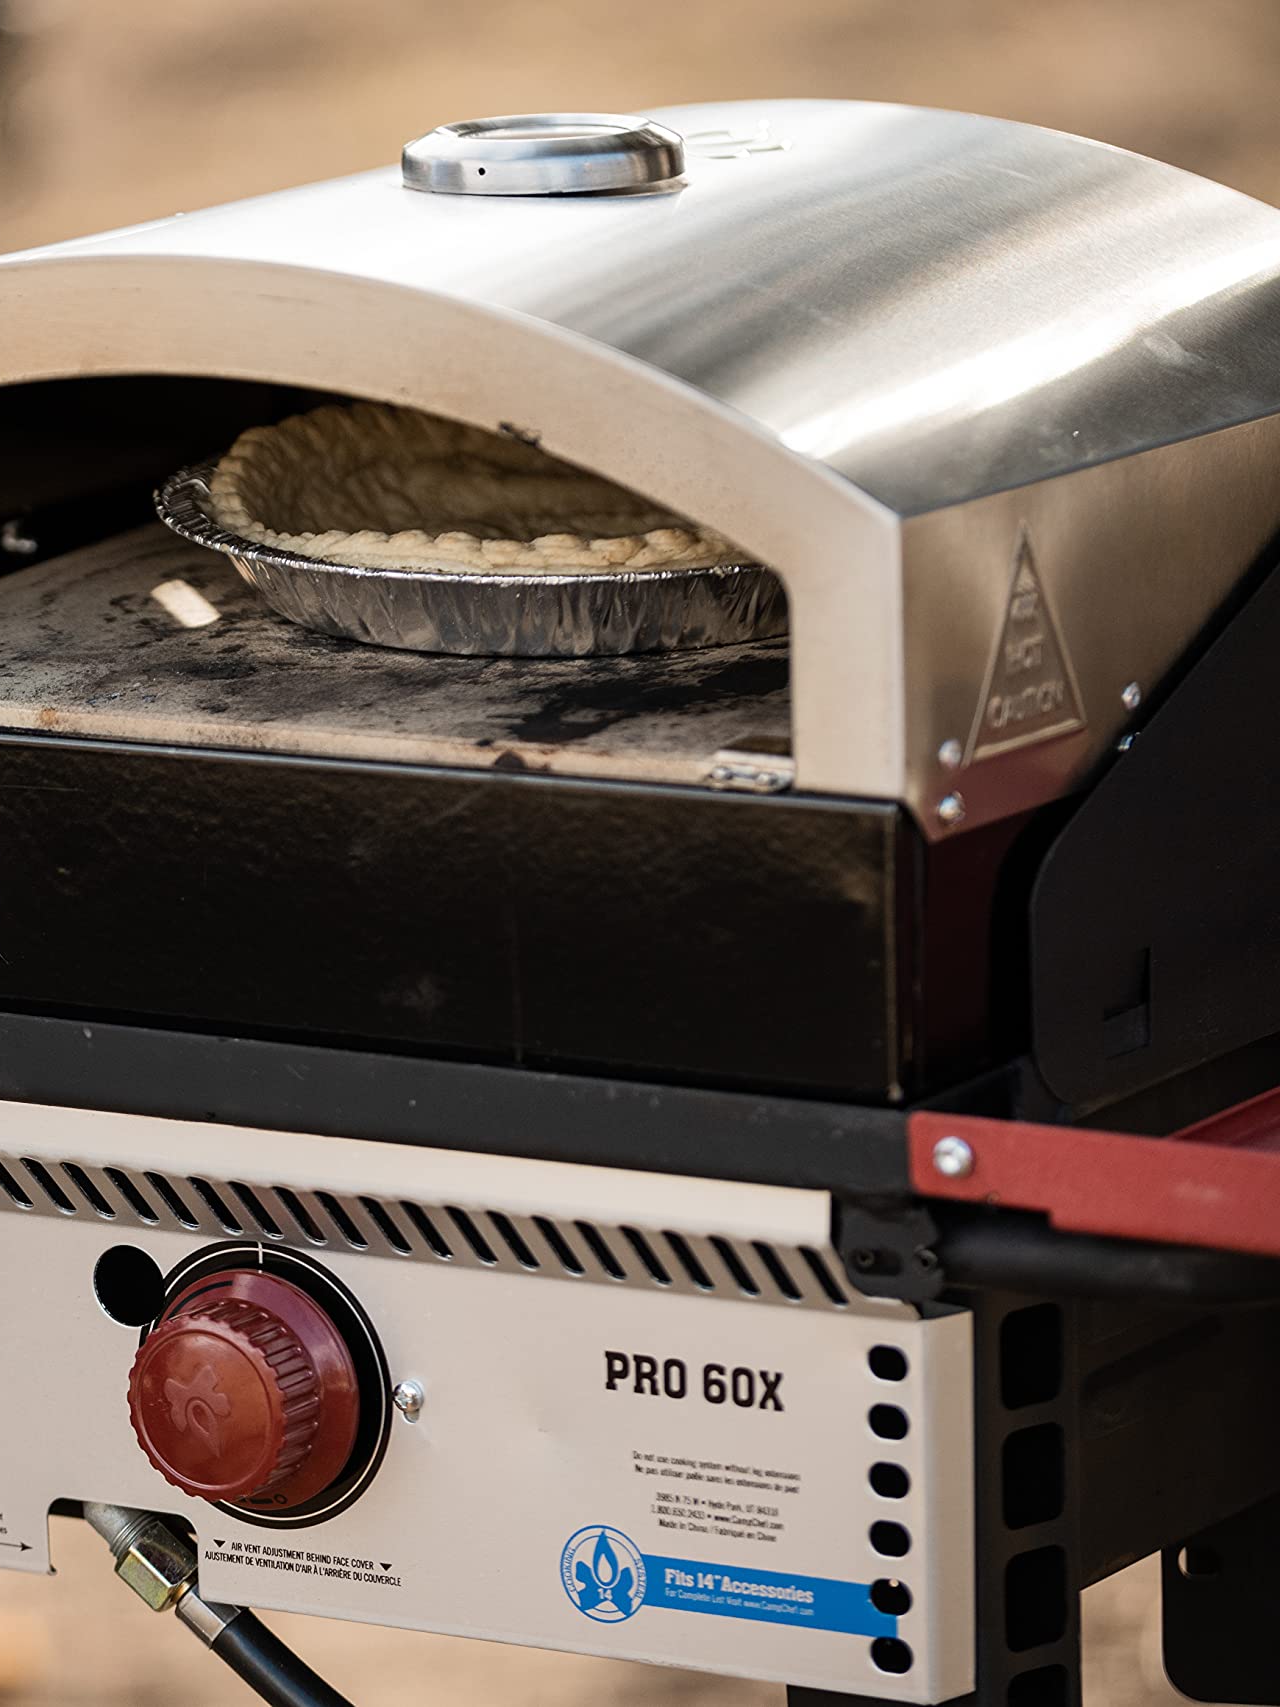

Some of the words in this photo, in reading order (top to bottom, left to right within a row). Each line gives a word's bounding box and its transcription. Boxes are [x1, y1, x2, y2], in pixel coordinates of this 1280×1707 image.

[604, 1350, 687, 1400] PRO
[702, 1363, 785, 1412] 60X
[205, 1551, 244, 1564] AJUSTEMENT
[245, 1556, 254, 1565] DE
[255, 1558, 296, 1571] VENTILATION
[295, 1563, 312, 1574] D'AIR
[319, 1567, 351, 1580] L'ARRIÈRE
[353, 1572, 362, 1581] DU
[364, 1573, 401, 1586] COUVERCLE
[232, 1542, 242, 1551] AIR
[244, 1544, 261, 1554] VENT
[263, 1546, 304, 1560] ADJUSTMENT
[306, 1553, 331, 1564] BEHIND
[333, 1556, 349, 1567] FACE
[351, 1559, 374, 1570] COVER
[597, 1588, 613, 1601] 14
[664, 1567, 694, 1588] Fits
[721, 1575, 814, 1604] Accessories
